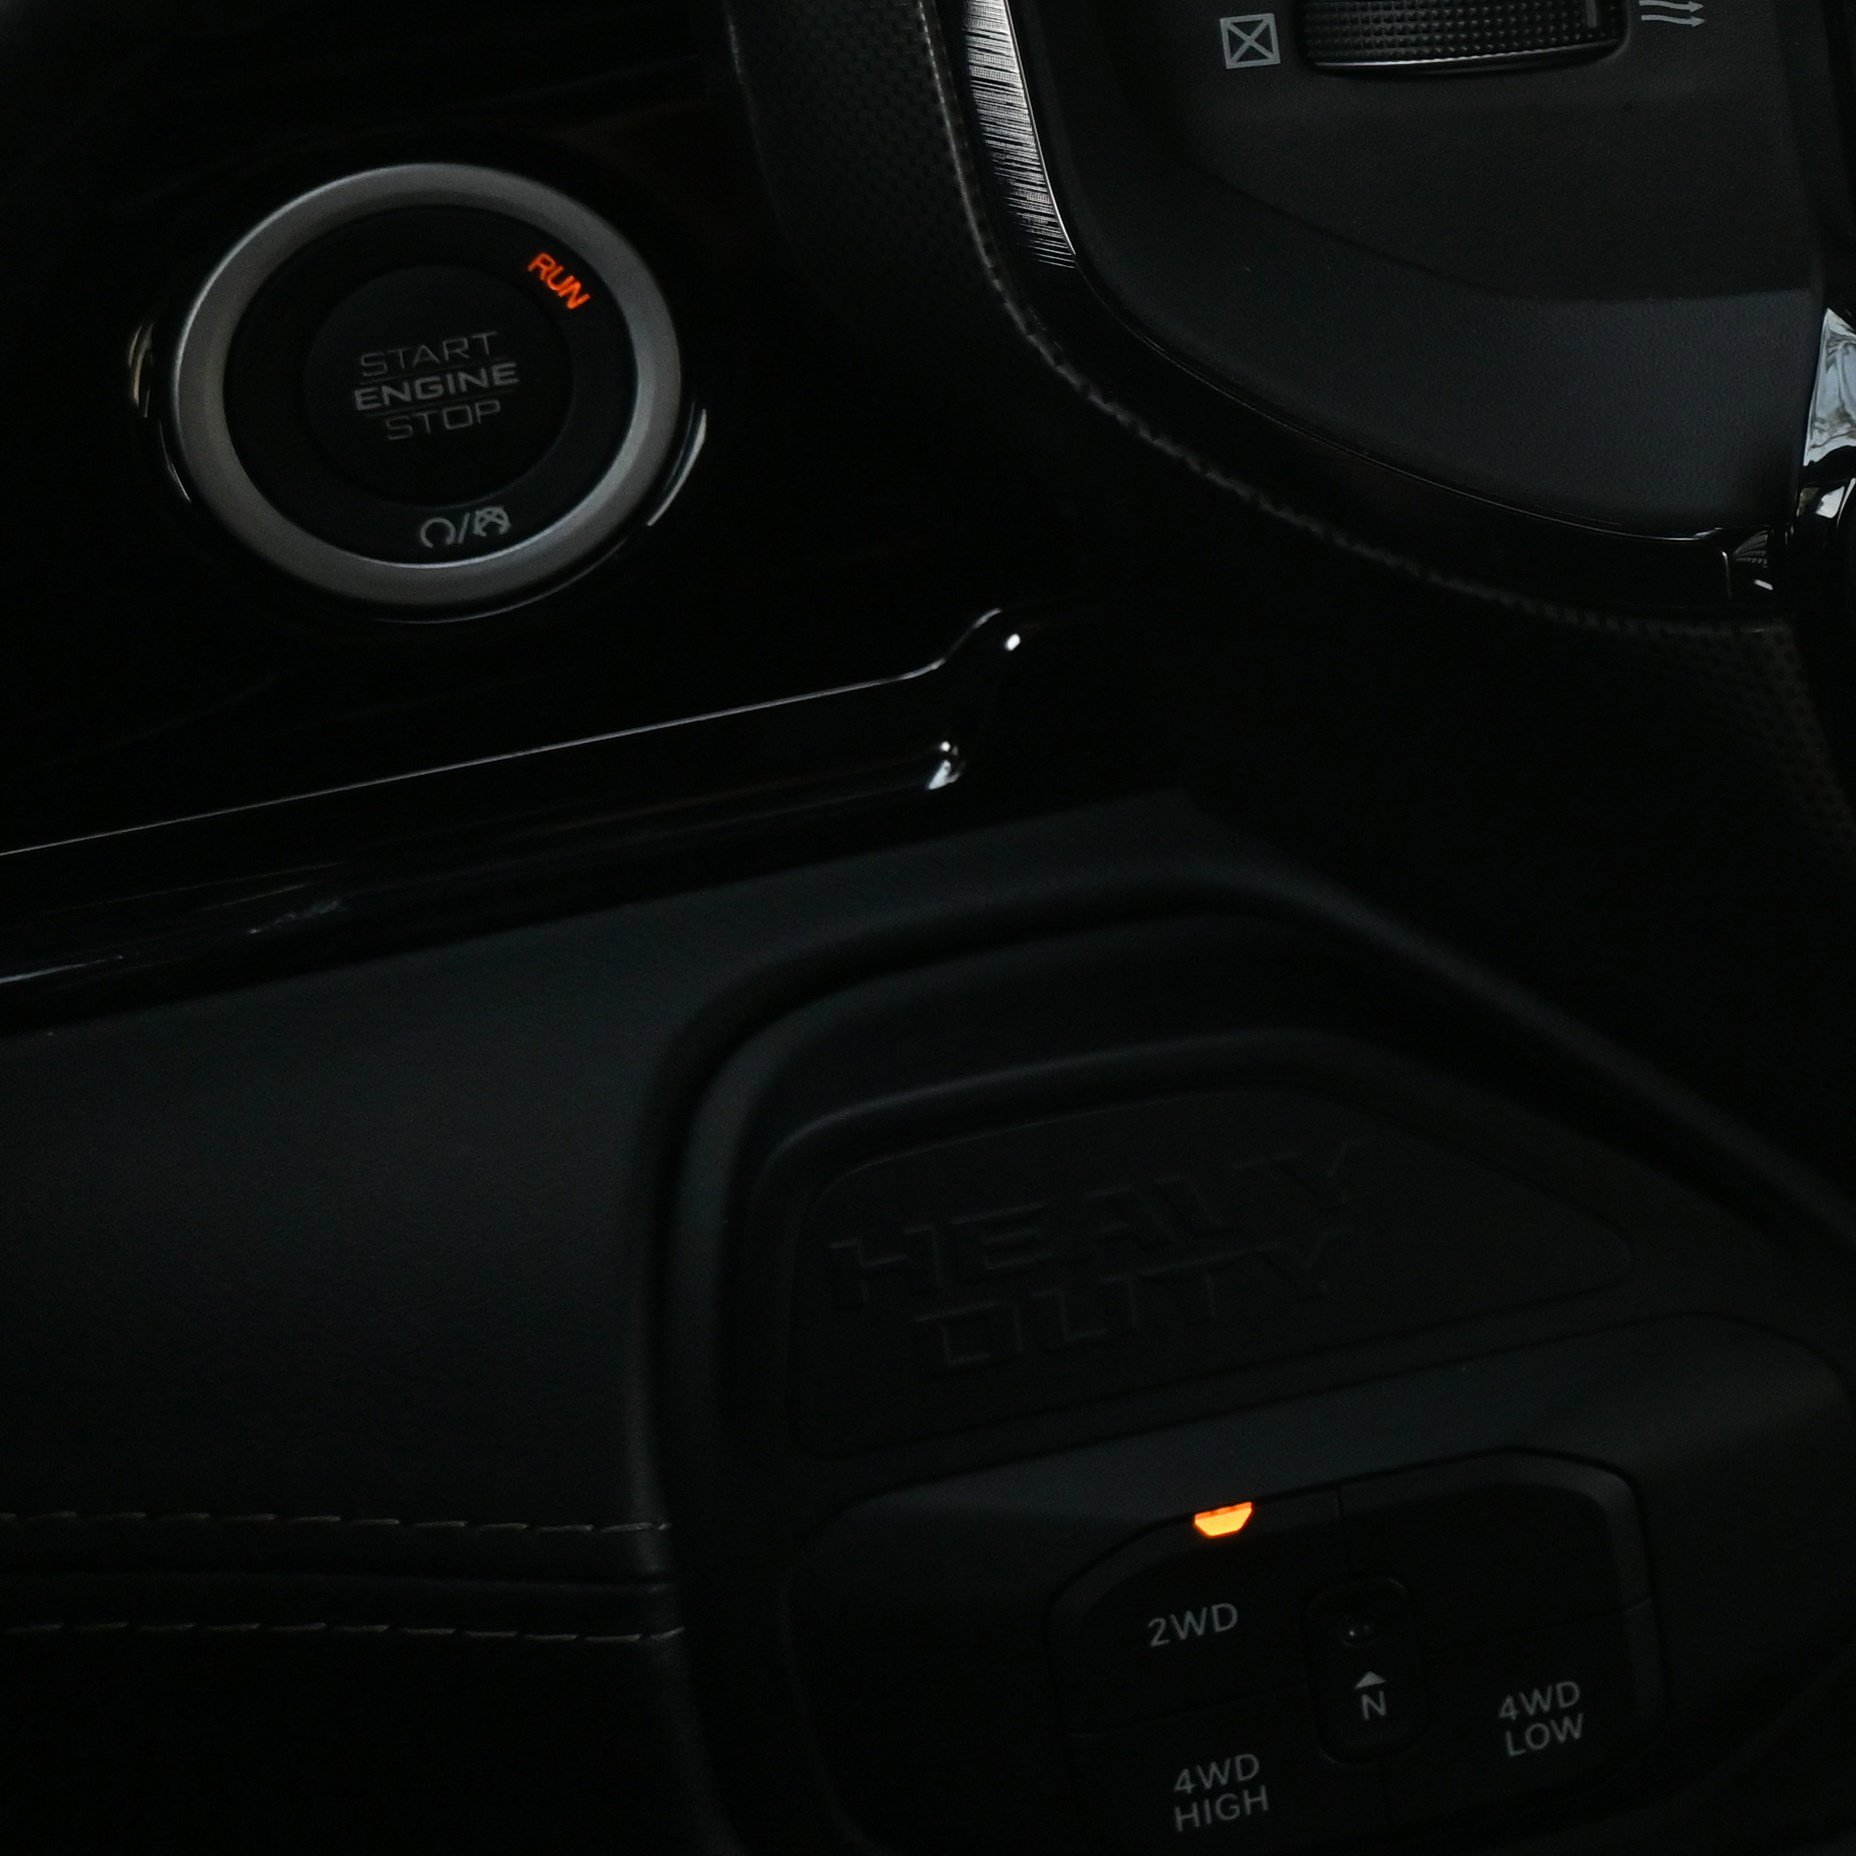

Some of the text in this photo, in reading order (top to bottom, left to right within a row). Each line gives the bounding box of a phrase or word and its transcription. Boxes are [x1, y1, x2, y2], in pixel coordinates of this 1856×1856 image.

[525, 250, 592, 312] RUN
[359, 329, 499, 378] START
[353, 361, 521, 412] ENGINE
[385, 398, 501, 441] STOP
[828, 1136, 1375, 1310] HEAVY
[913, 1225, 1356, 1380] DUTY
[1146, 1601, 1239, 1649] 2WD
[1360, 1690, 1388, 1723] N
[1498, 1679, 1582, 1723] 4WD
[1504, 1712, 1585, 1759] LOW
[1173, 1751, 1261, 1797] 4WD
[1173, 1784, 1272, 1834] HIGH
